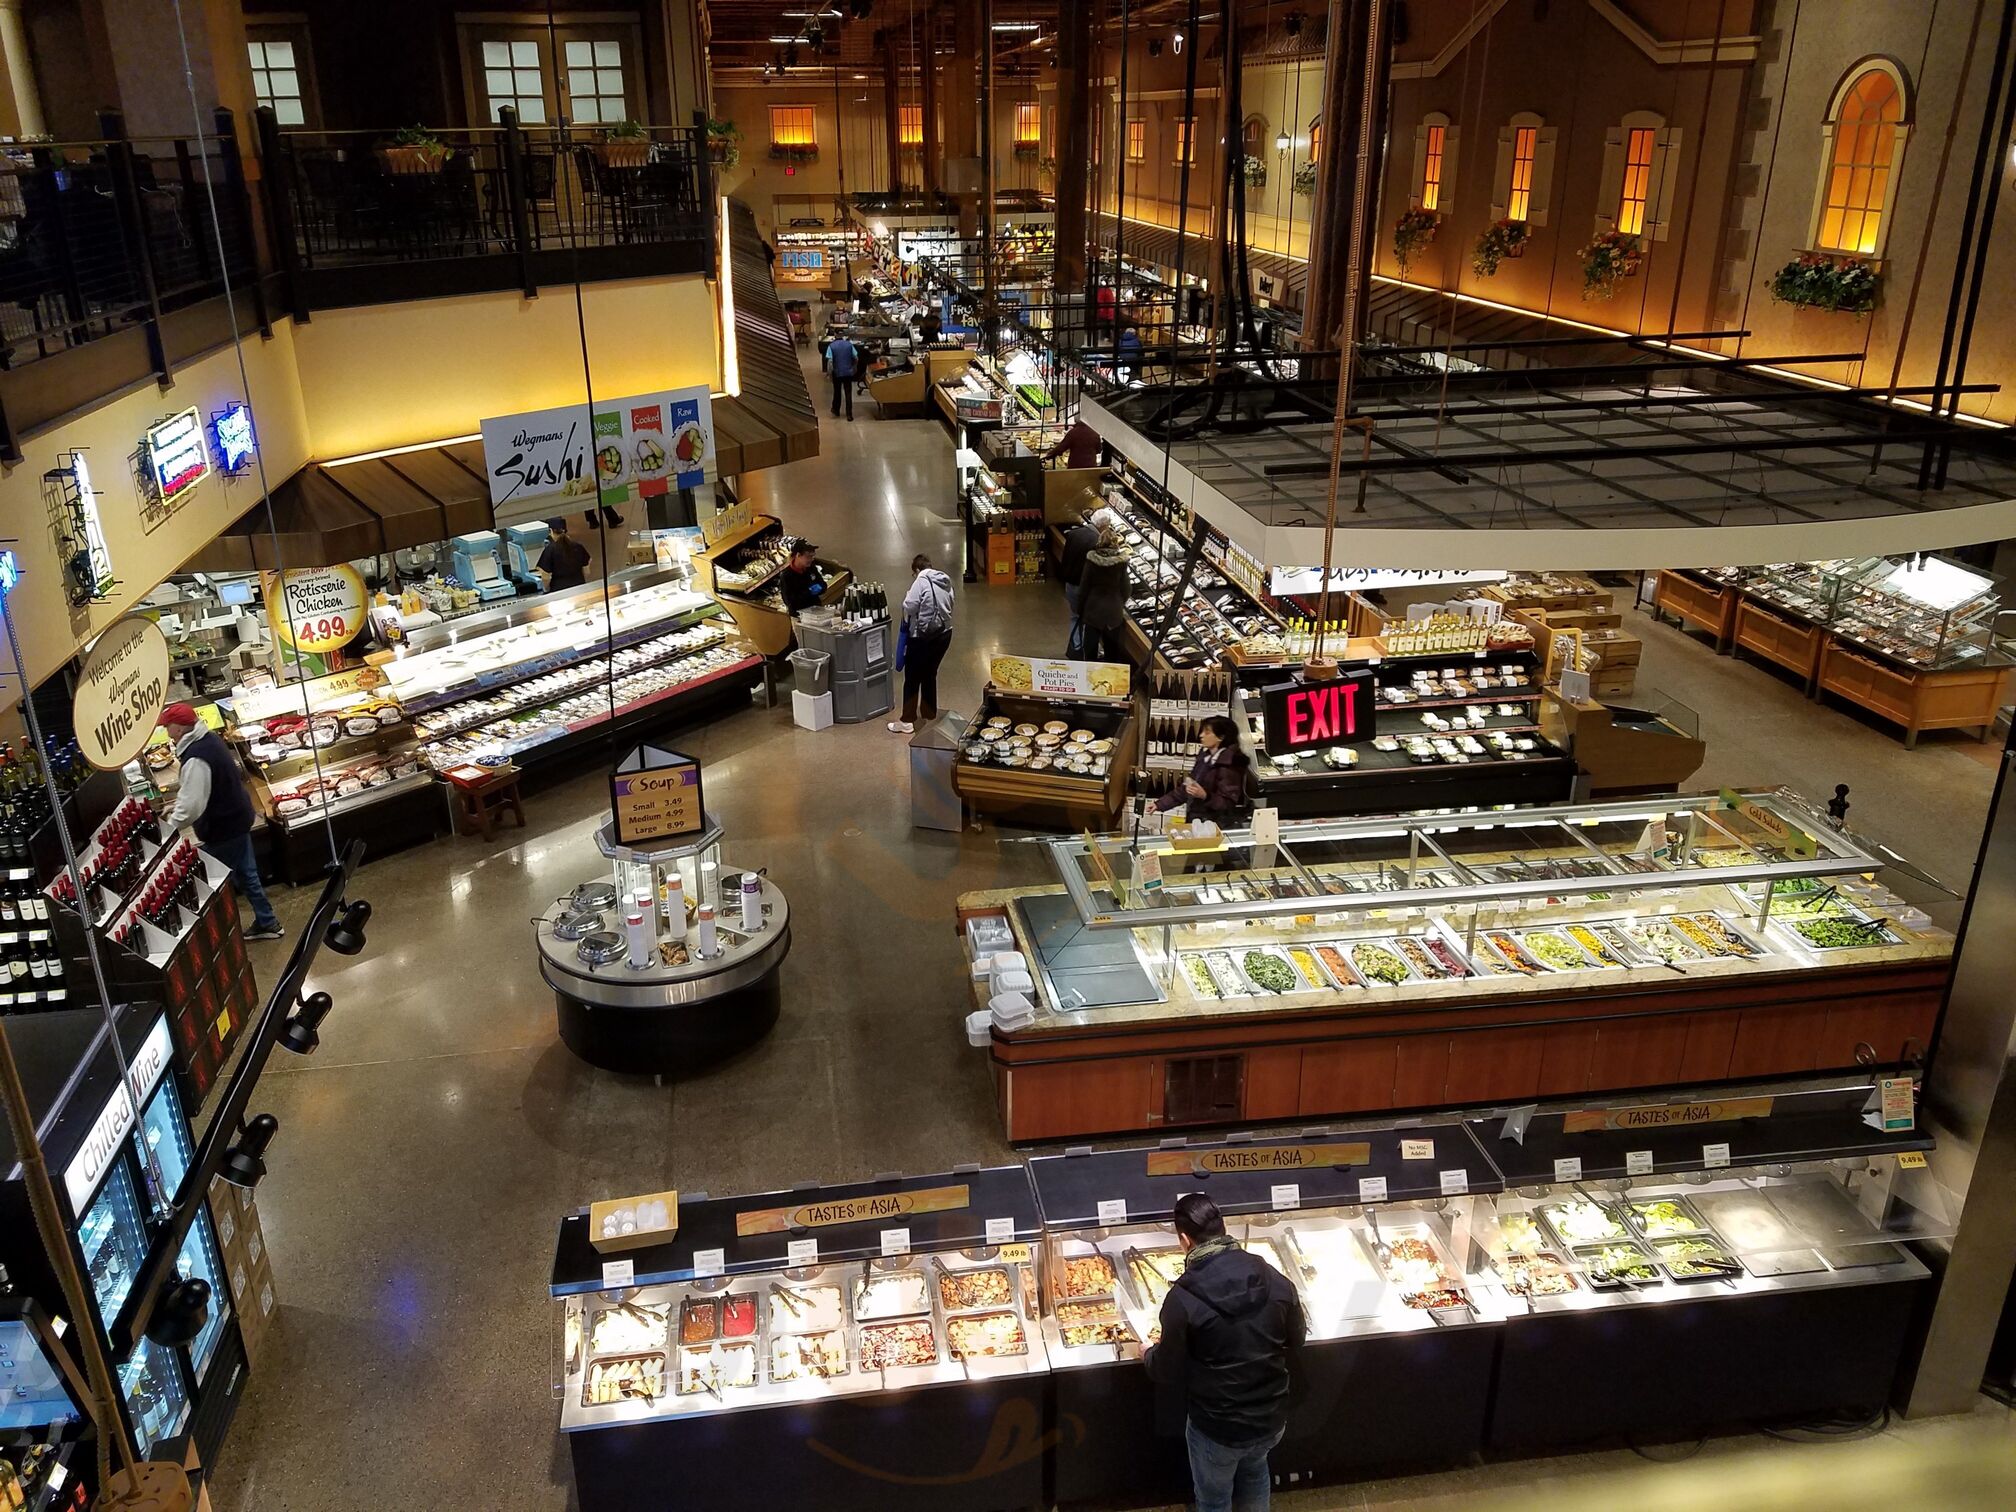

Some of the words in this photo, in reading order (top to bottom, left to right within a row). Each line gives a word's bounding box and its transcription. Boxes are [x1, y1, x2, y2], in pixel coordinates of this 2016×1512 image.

[633, 411, 660, 425] Cooked
[677, 407, 692, 417] Raw
[594, 420, 619, 433] Veggie
[511, 429, 563, 452] Wegmans
[493, 422, 584, 511] Sushi
[286, 578, 346, 600] Rotisserie
[296, 595, 343, 614] Chicken
[88, 648, 124, 687] Welcome
[123, 641, 132, 656] to
[131, 630, 144, 650] the
[1037, 669, 1067, 680] Quiche
[1044, 679, 1057, 687] Pot
[1059, 679, 1075, 688] Pies
[108, 665, 141, 705] Wegmans
[94, 712, 132, 756] Wine
[130, 677, 161, 722] Shop
[1287, 683, 1359, 744] EXIT
[640, 778, 675, 791] Soup
[633, 802, 655, 812] Small
[664, 797, 682, 807] 3.49
[628, 814, 661, 824] Medium
[665, 809, 684, 818] 4.99
[635, 825, 658, 834] Large
[666, 821, 685, 830] 8.99
[1628, 1109, 1670, 1125] TASTES
[1683, 1105, 1710, 1121] ASIA
[83, 1089, 130, 1182] Chilled
[1213, 1152, 1259, 1168] TASTES
[1272, 1149, 1302, 1166] ASIA
[807, 1203, 855, 1222] TASTES
[870, 1197, 901, 1215] ASIA
[1003, 1249, 1019, 1258] 9.49
